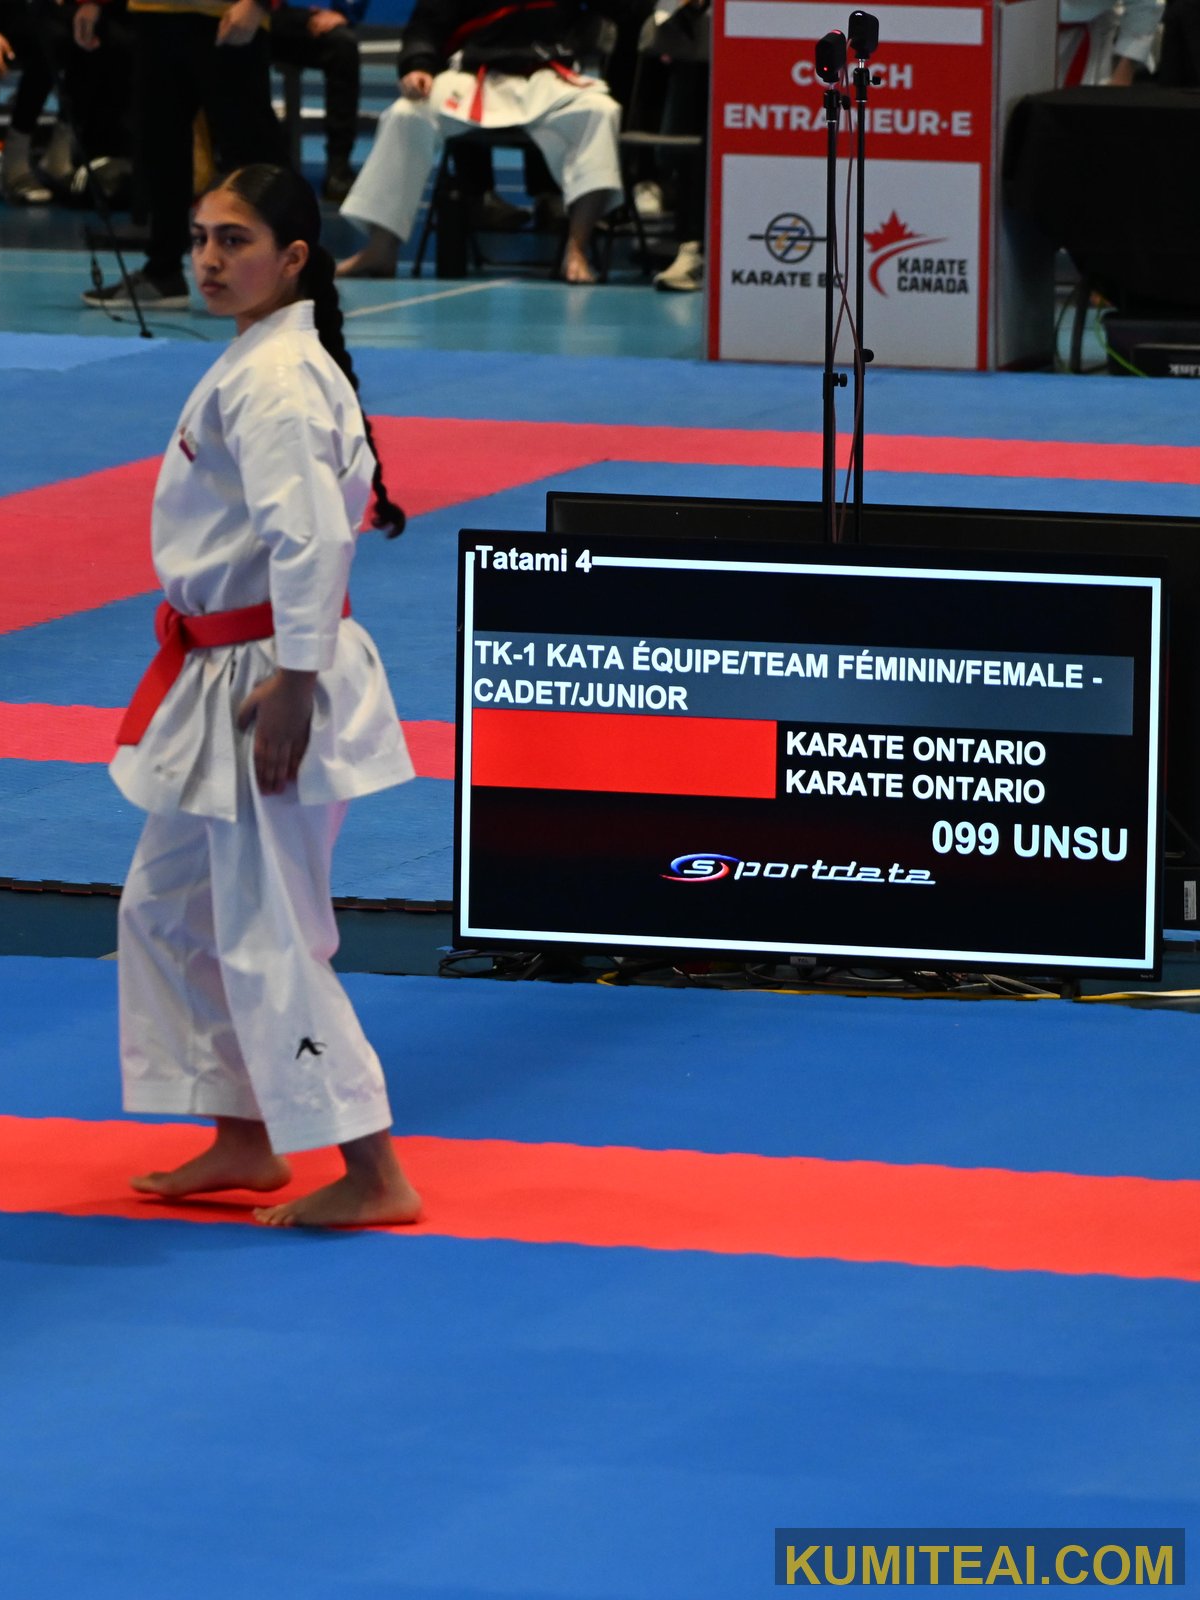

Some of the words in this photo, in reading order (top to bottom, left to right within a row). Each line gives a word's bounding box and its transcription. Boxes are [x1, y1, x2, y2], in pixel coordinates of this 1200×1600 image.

[791, 60, 913, 89] CCH
[731, 269, 812, 287] KARATE
[897, 257, 968, 276] KARATE
[897, 276, 969, 294] CANADA
[475, 545, 567, 572] Tatami
[575, 549, 592, 573] 4
[474, 640, 535, 666] TK-1
[547, 643, 624, 670] KATA
[632, 641, 828, 679] ÉQUIPE/TEAM
[838, 649, 1083, 688] FÉMININ/FEMALE
[474, 678, 688, 711] CADET/JUNIOR
[786, 731, 904, 760] KARATE
[912, 736, 1046, 766] ONTARIO
[786, 769, 903, 798] KARATE
[912, 774, 1046, 804] ONTARIO
[932, 820, 1000, 856] 099
[1013, 823, 1128, 862] UNSU
